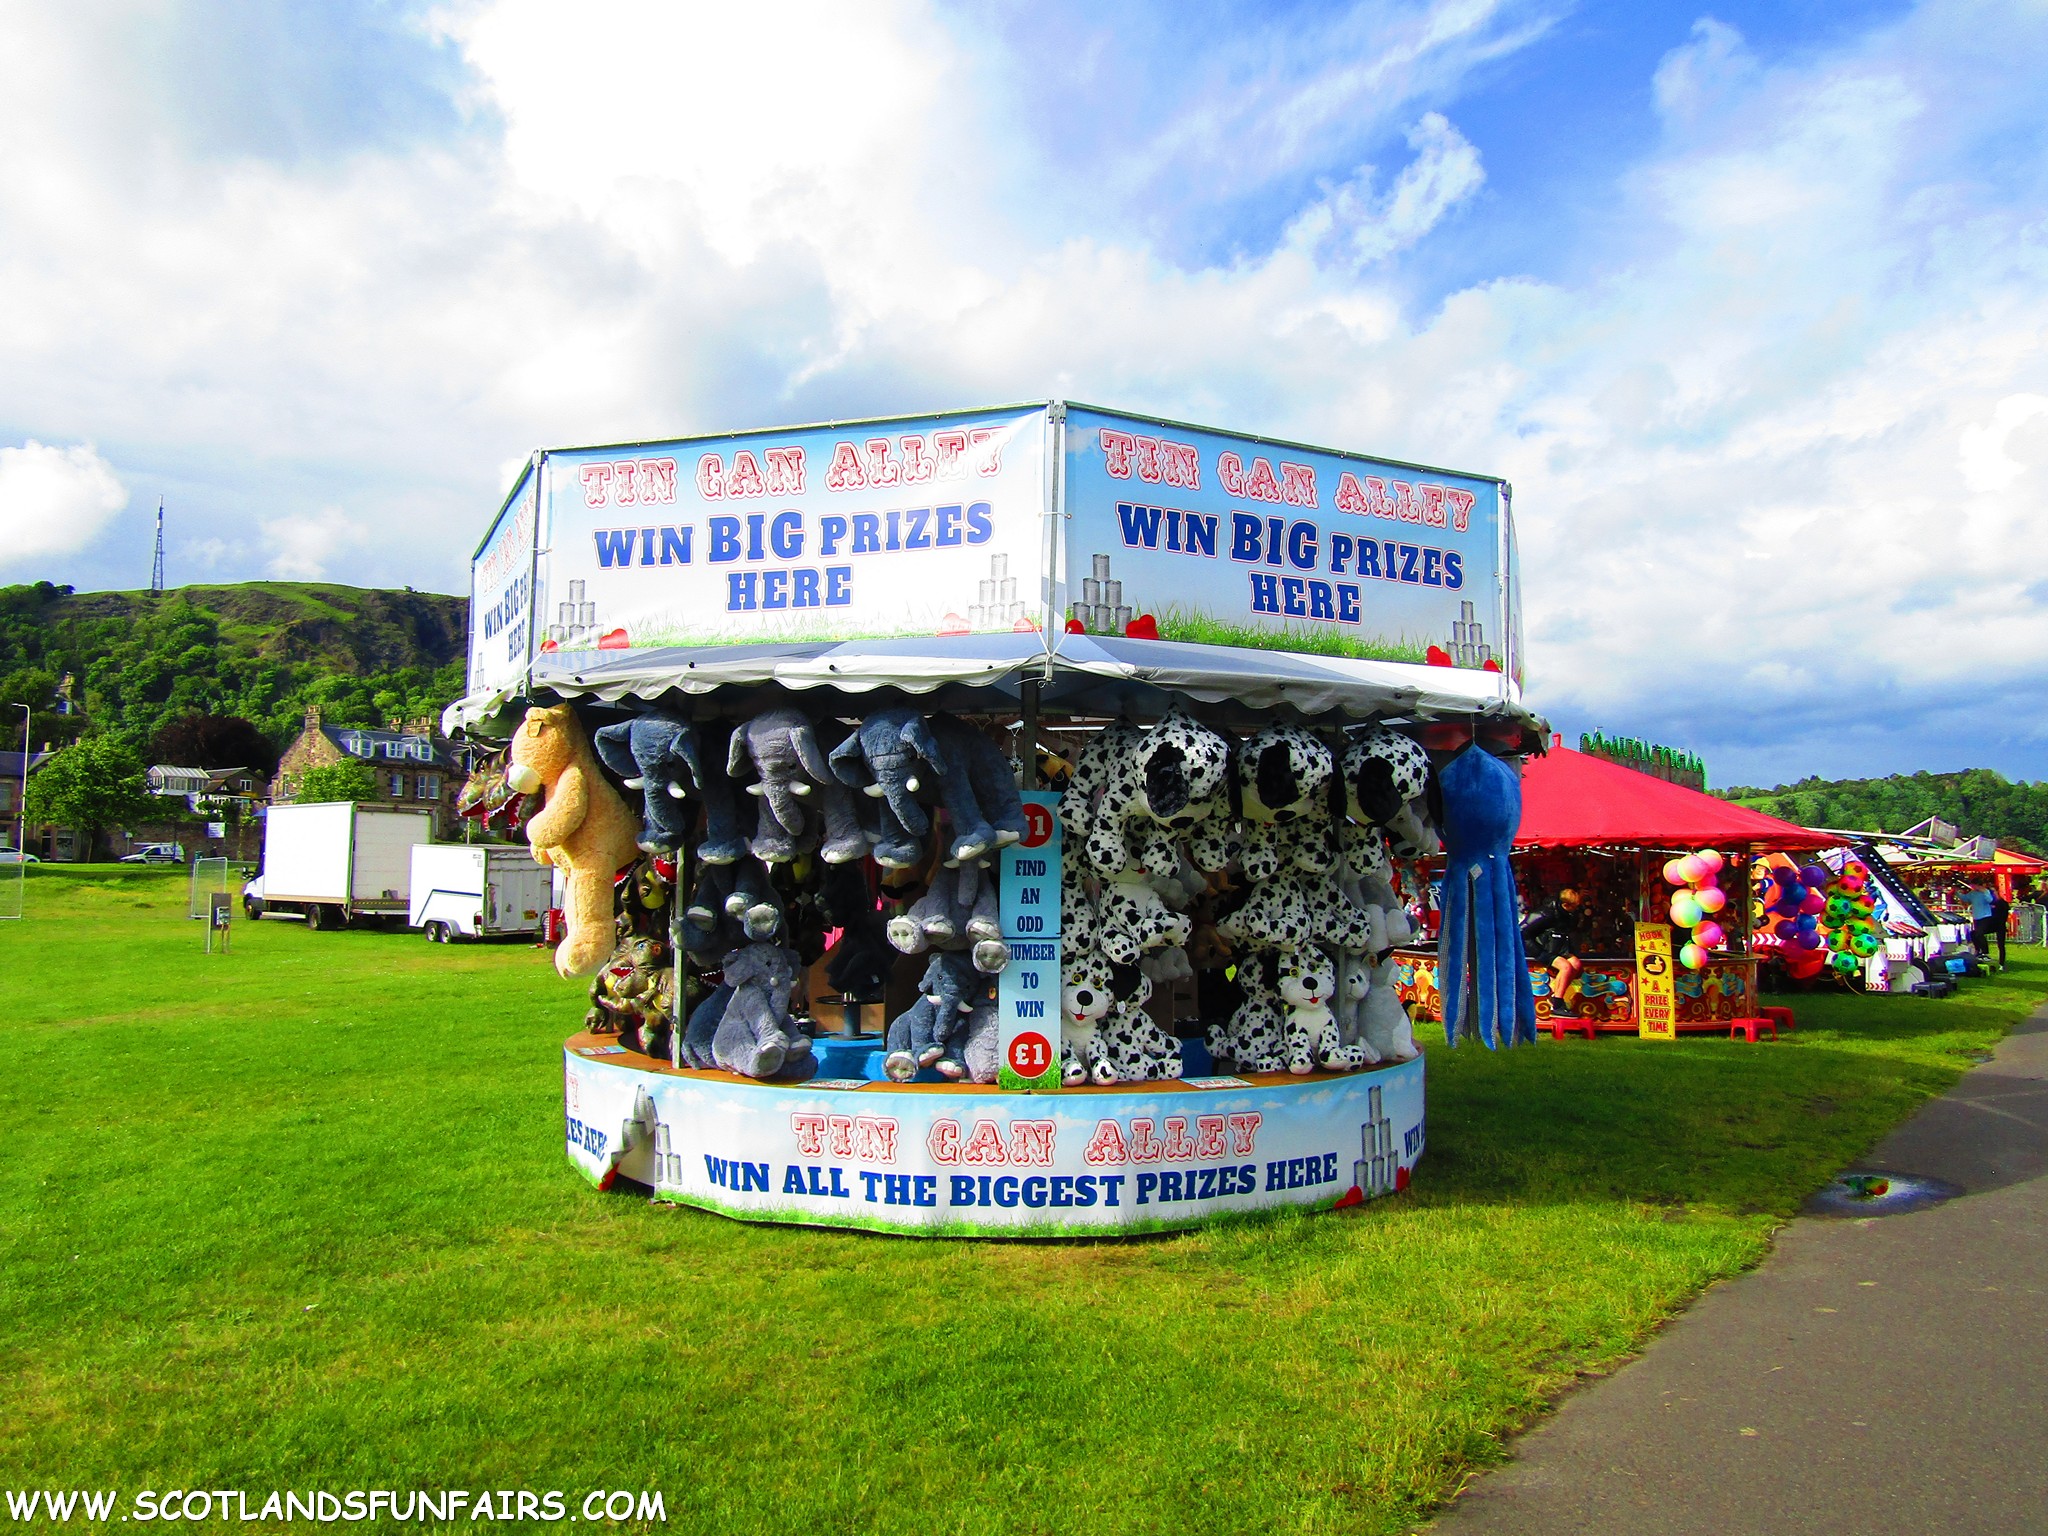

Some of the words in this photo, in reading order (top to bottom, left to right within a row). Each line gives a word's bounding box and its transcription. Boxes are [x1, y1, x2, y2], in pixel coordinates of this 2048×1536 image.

[579, 457, 679, 509] TIN
[695, 445, 806, 502] CAN
[825, 425, 1010, 491] ALLEY
[1099, 428, 1201, 491] TIN
[1217, 451, 1319, 509] CAN
[1334, 471, 1476, 533] ALLEY
[594, 524, 694, 571] WIN
[707, 510, 804, 563] BIG
[819, 502, 994, 557] PRIZES
[1117, 503, 1219, 558] WIN
[1230, 510, 1319, 570] BIG
[1330, 532, 1464, 591] PRIZES
[726, 565, 853, 612] HERE
[1250, 571, 1361, 624] HERE
[485, 602, 504, 641] WIN
[504, 578, 519, 626] BIG
[508, 617, 525, 663] HERE
[1015, 859, 1047, 877] FIND
[1020, 887, 1041, 905] AN
[1016, 915, 1044, 933] ODD
[1021, 972, 1039, 989] TO
[1652, 980, 1660, 993] A
[1015, 1000, 1045, 1018] WIN
[1644, 993, 1669, 1006] PRIZE
[1644, 1007, 1670, 1020] EVERY
[1647, 1020, 1669, 1032] TIME
[1015, 1043, 1045, 1065] £1
[790, 1111, 899, 1165] TIN
[928, 1117, 1058, 1167] CAN
[1083, 1111, 1263, 1167] ALLEY
[1404, 1122, 1420, 1158] WIN
[704, 1154, 770, 1191] WIN
[782, 1164, 850, 1199] ALL
[859, 1171, 938, 1207] THE
[949, 1175, 1125, 1208] BIGGEST
[1136, 1164, 1257, 1205] PRIZES
[1265, 1151, 1338, 1192] HERE
